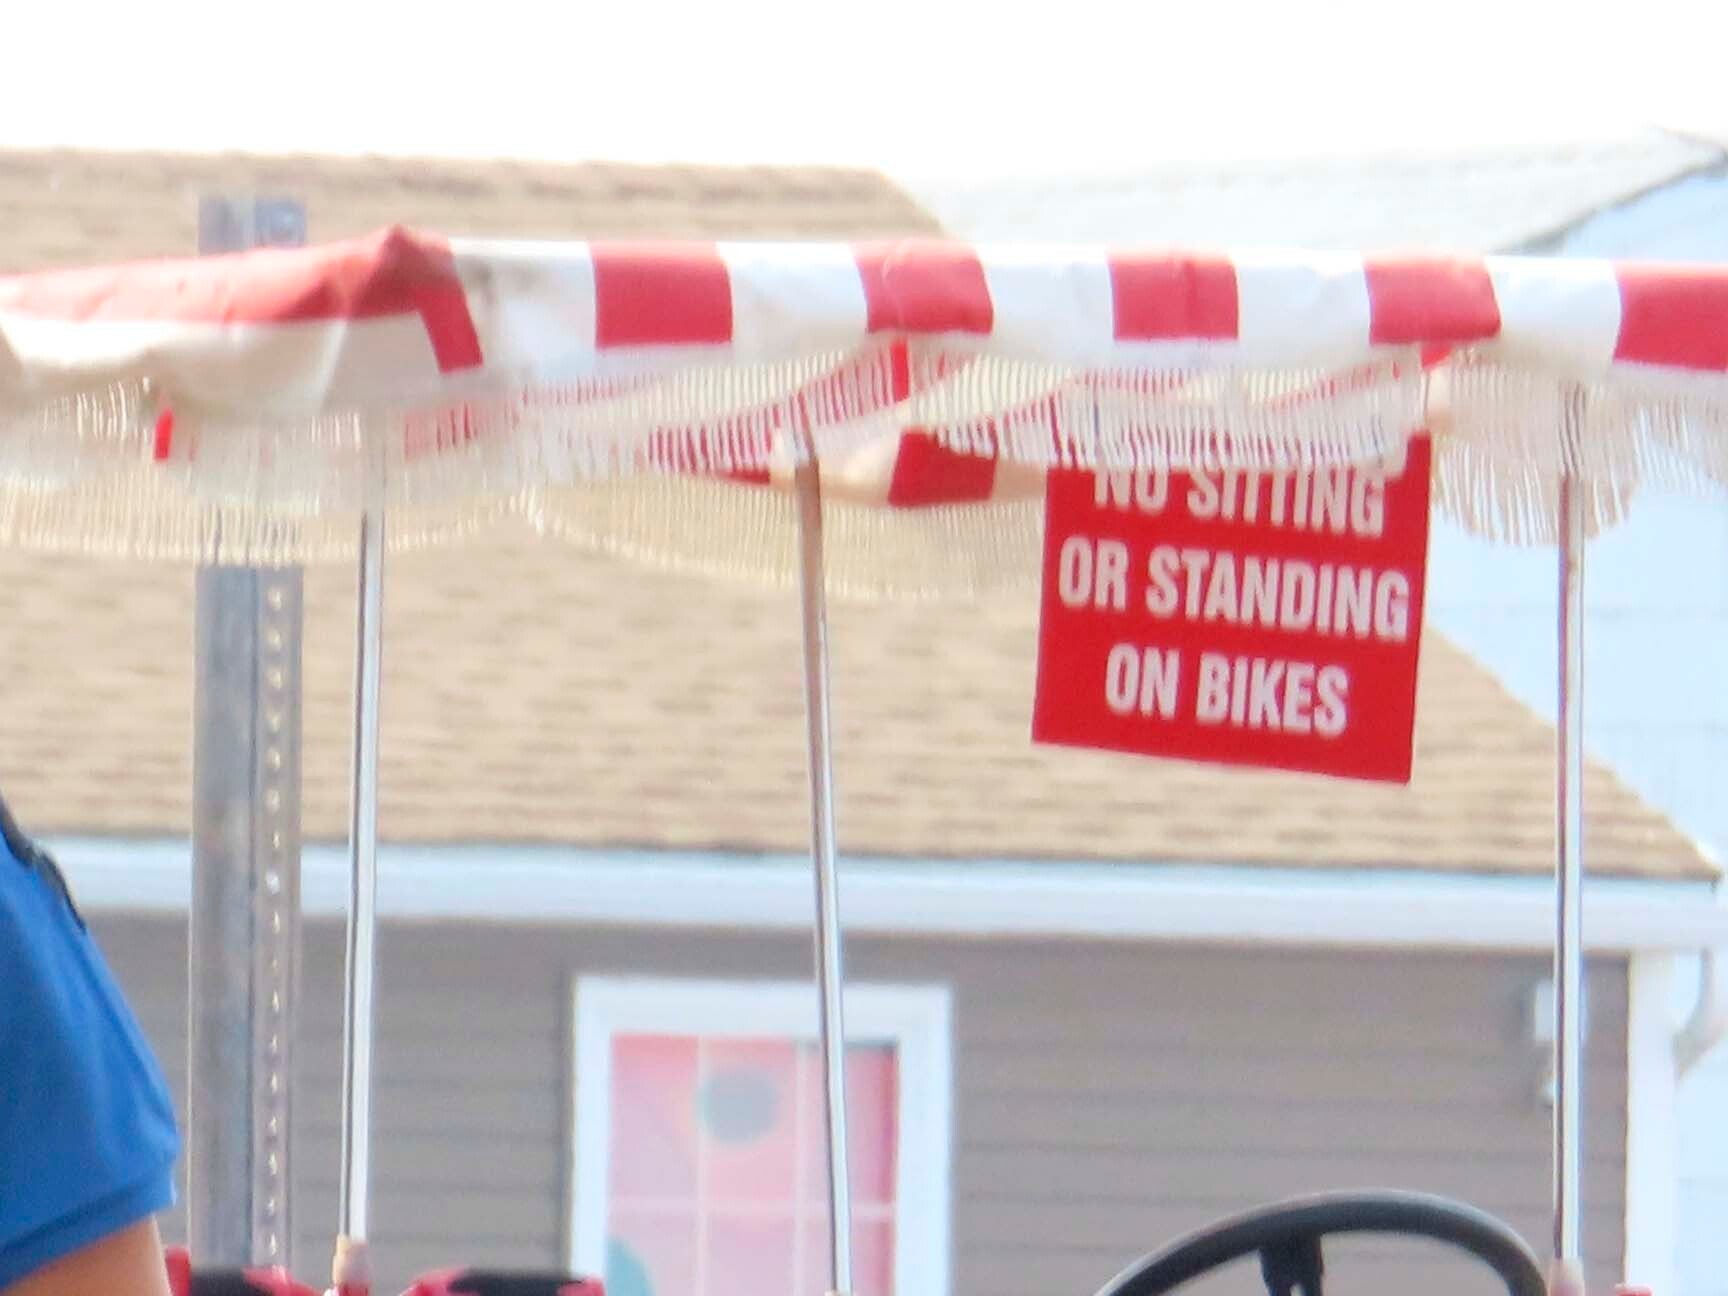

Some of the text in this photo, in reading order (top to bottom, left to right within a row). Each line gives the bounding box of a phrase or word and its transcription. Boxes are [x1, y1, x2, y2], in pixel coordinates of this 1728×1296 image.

[1094, 465, 1385, 538] NO SITTING
[1058, 536, 1410, 642] OR STANDING
[1105, 642, 1350, 738] ON BIKES
